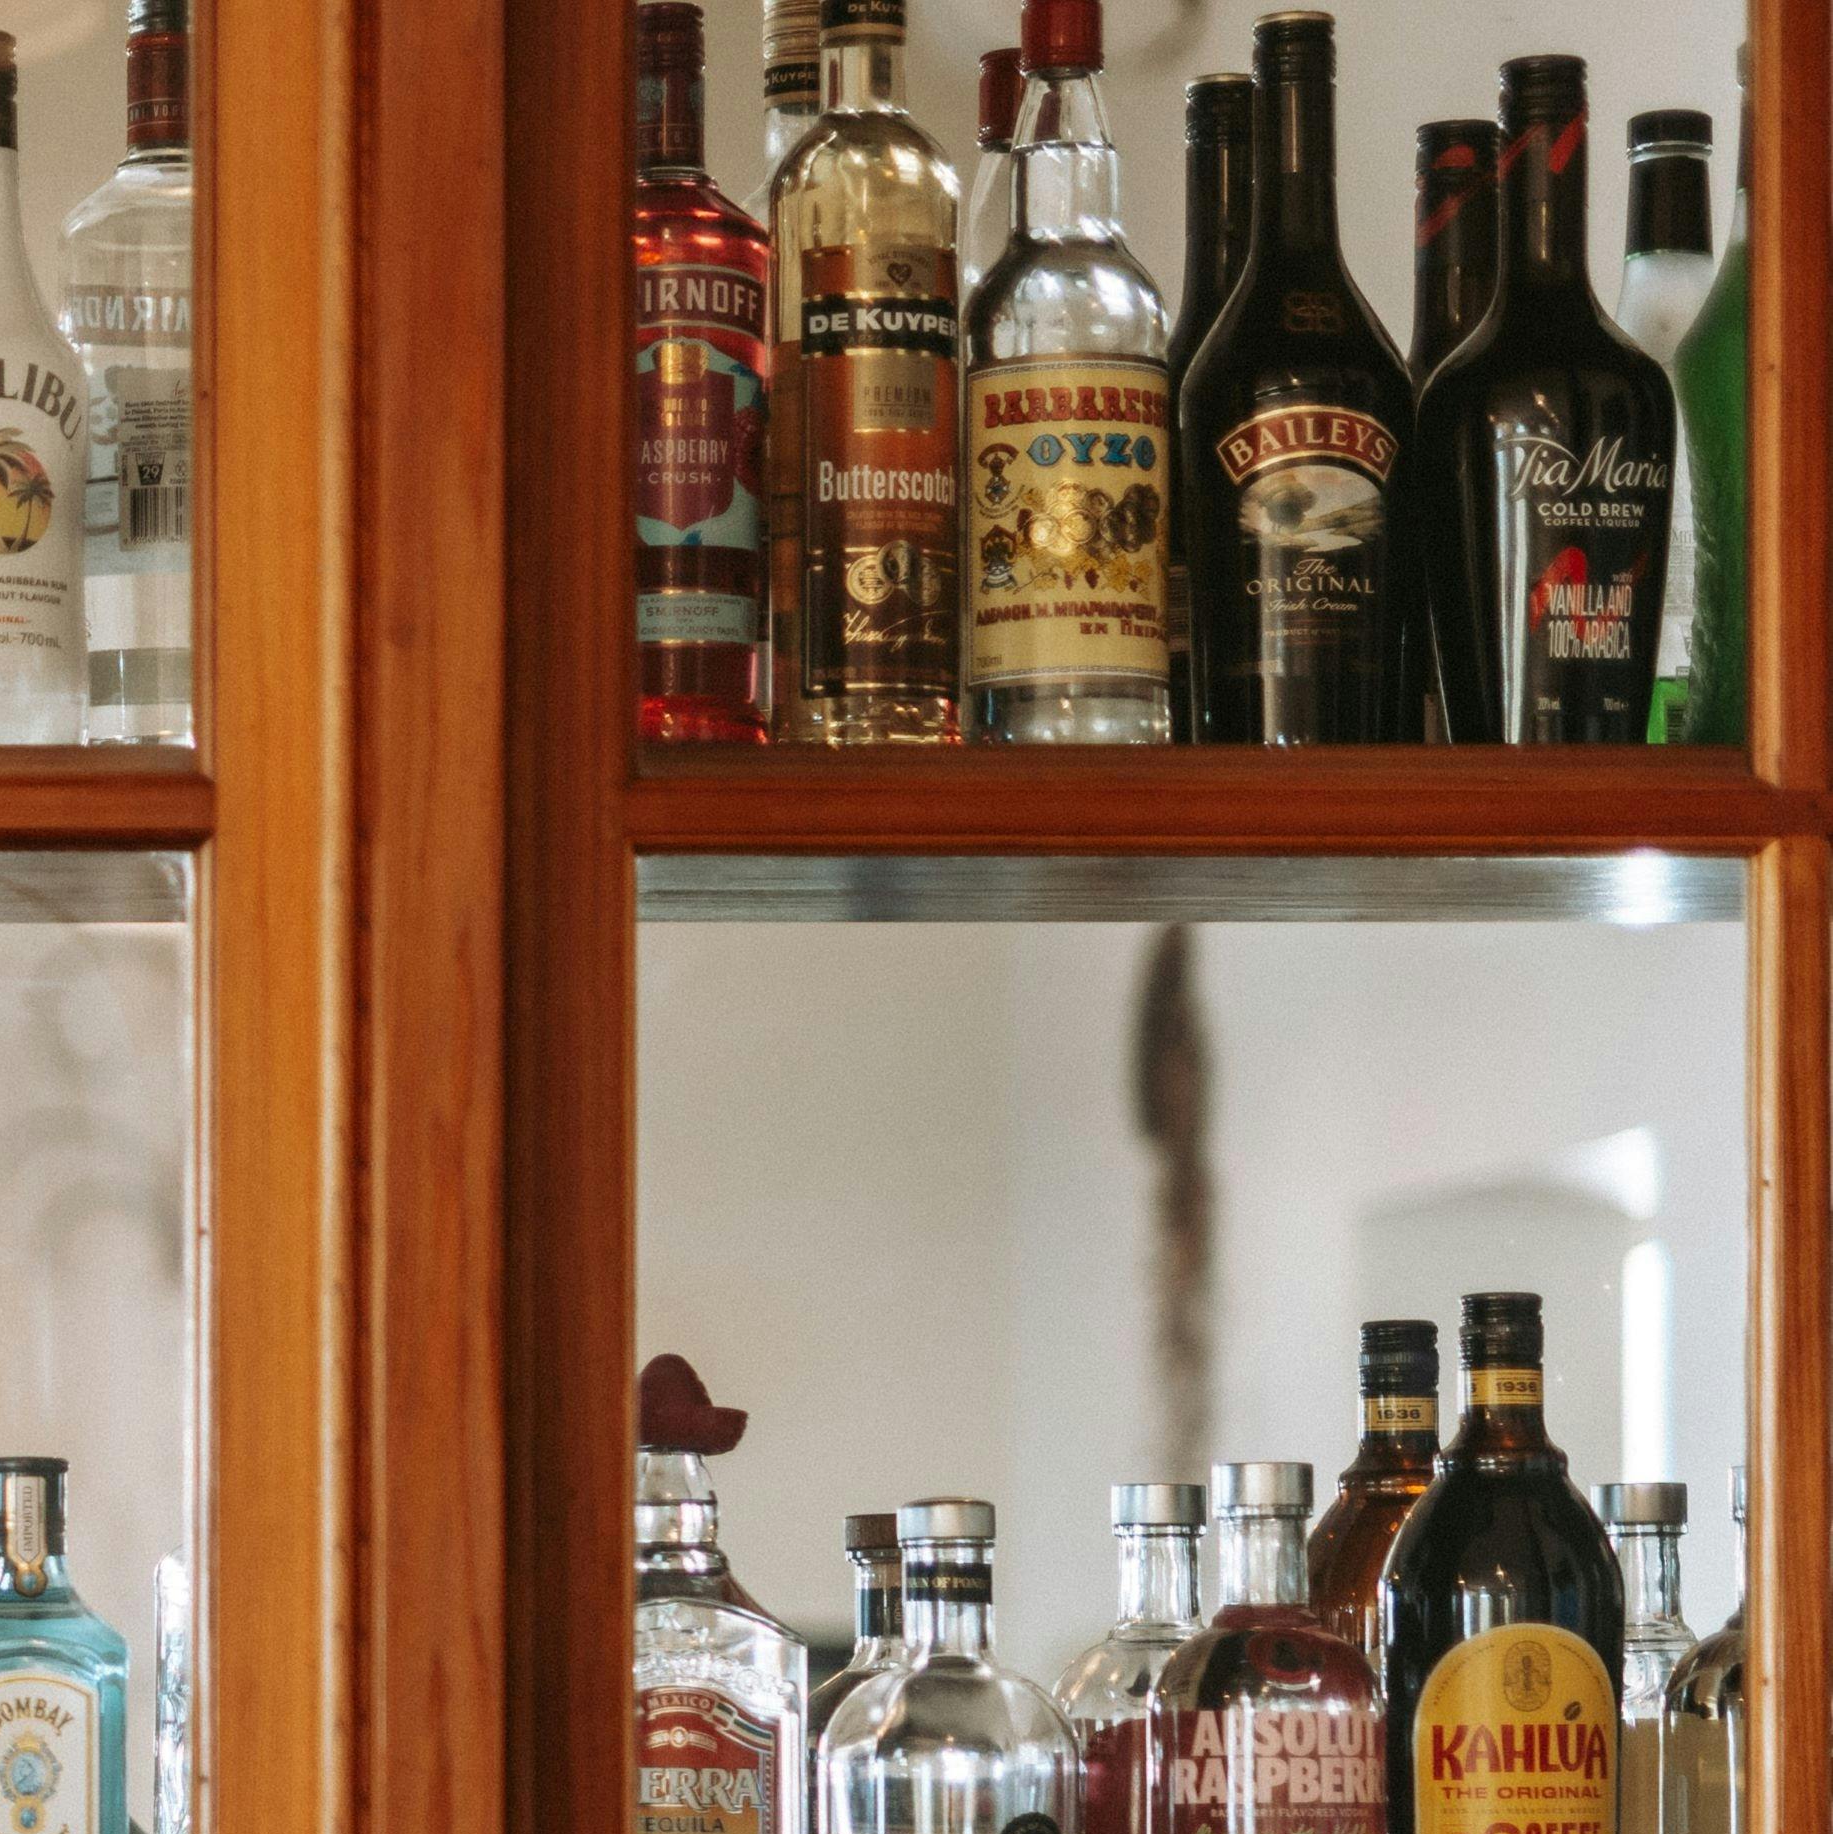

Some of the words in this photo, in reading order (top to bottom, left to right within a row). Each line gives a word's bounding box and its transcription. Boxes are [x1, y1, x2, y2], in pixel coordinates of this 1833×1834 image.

[771, 71, 817, 85] KUYPE
[644, 277, 757, 321] IRNOFF
[809, 313, 849, 334] DE
[856, 308, 957, 337] KUYPER
[984, 386, 1167, 429] BARBARESS
[641, 439, 729, 465] ASPBERRY
[1229, 417, 1394, 468] BAILEYS
[141, 465, 160, 479] 29
[1500, 436, 1581, 497] Tia
[1561, 435, 1668, 497] Maria
[648, 473, 713, 485] CRUSH
[819, 460, 956, 506] Butterscotch
[1538, 502, 1593, 517] COLD
[1599, 503, 1645, 518] BREW
[1544, 518, 1590, 527] COFFEE
[1596, 518, 1641, 528] LIQUEUR
[1293, 558, 1339, 577] The
[1246, 575, 1375, 595] ORIGINAL
[19, 591, 61, 606] FLAVOUR
[1265, 598, 1308, 613] Irish
[1311, 597, 1359, 612] Cream
[1547, 584, 1604, 617] VANILLA
[1606, 584, 1633, 617] AND
[1548, 621, 1580, 658] 100%
[1582, 621, 1631, 659] ARABICA
[1496, 1381, 1537, 1393] 1936
[1377, 1409, 1421, 1420] 1936
[648, 1693, 711, 1709] MEXICO
[639, 1766, 767, 1813] ERRA
[1173, 1756, 1383, 1804] RASPBERR
[1441, 1786, 1487, 1799] THE
[1497, 1786, 1601, 1800] ORIGINAL
[644, 1816, 727, 1834] EQUILA
